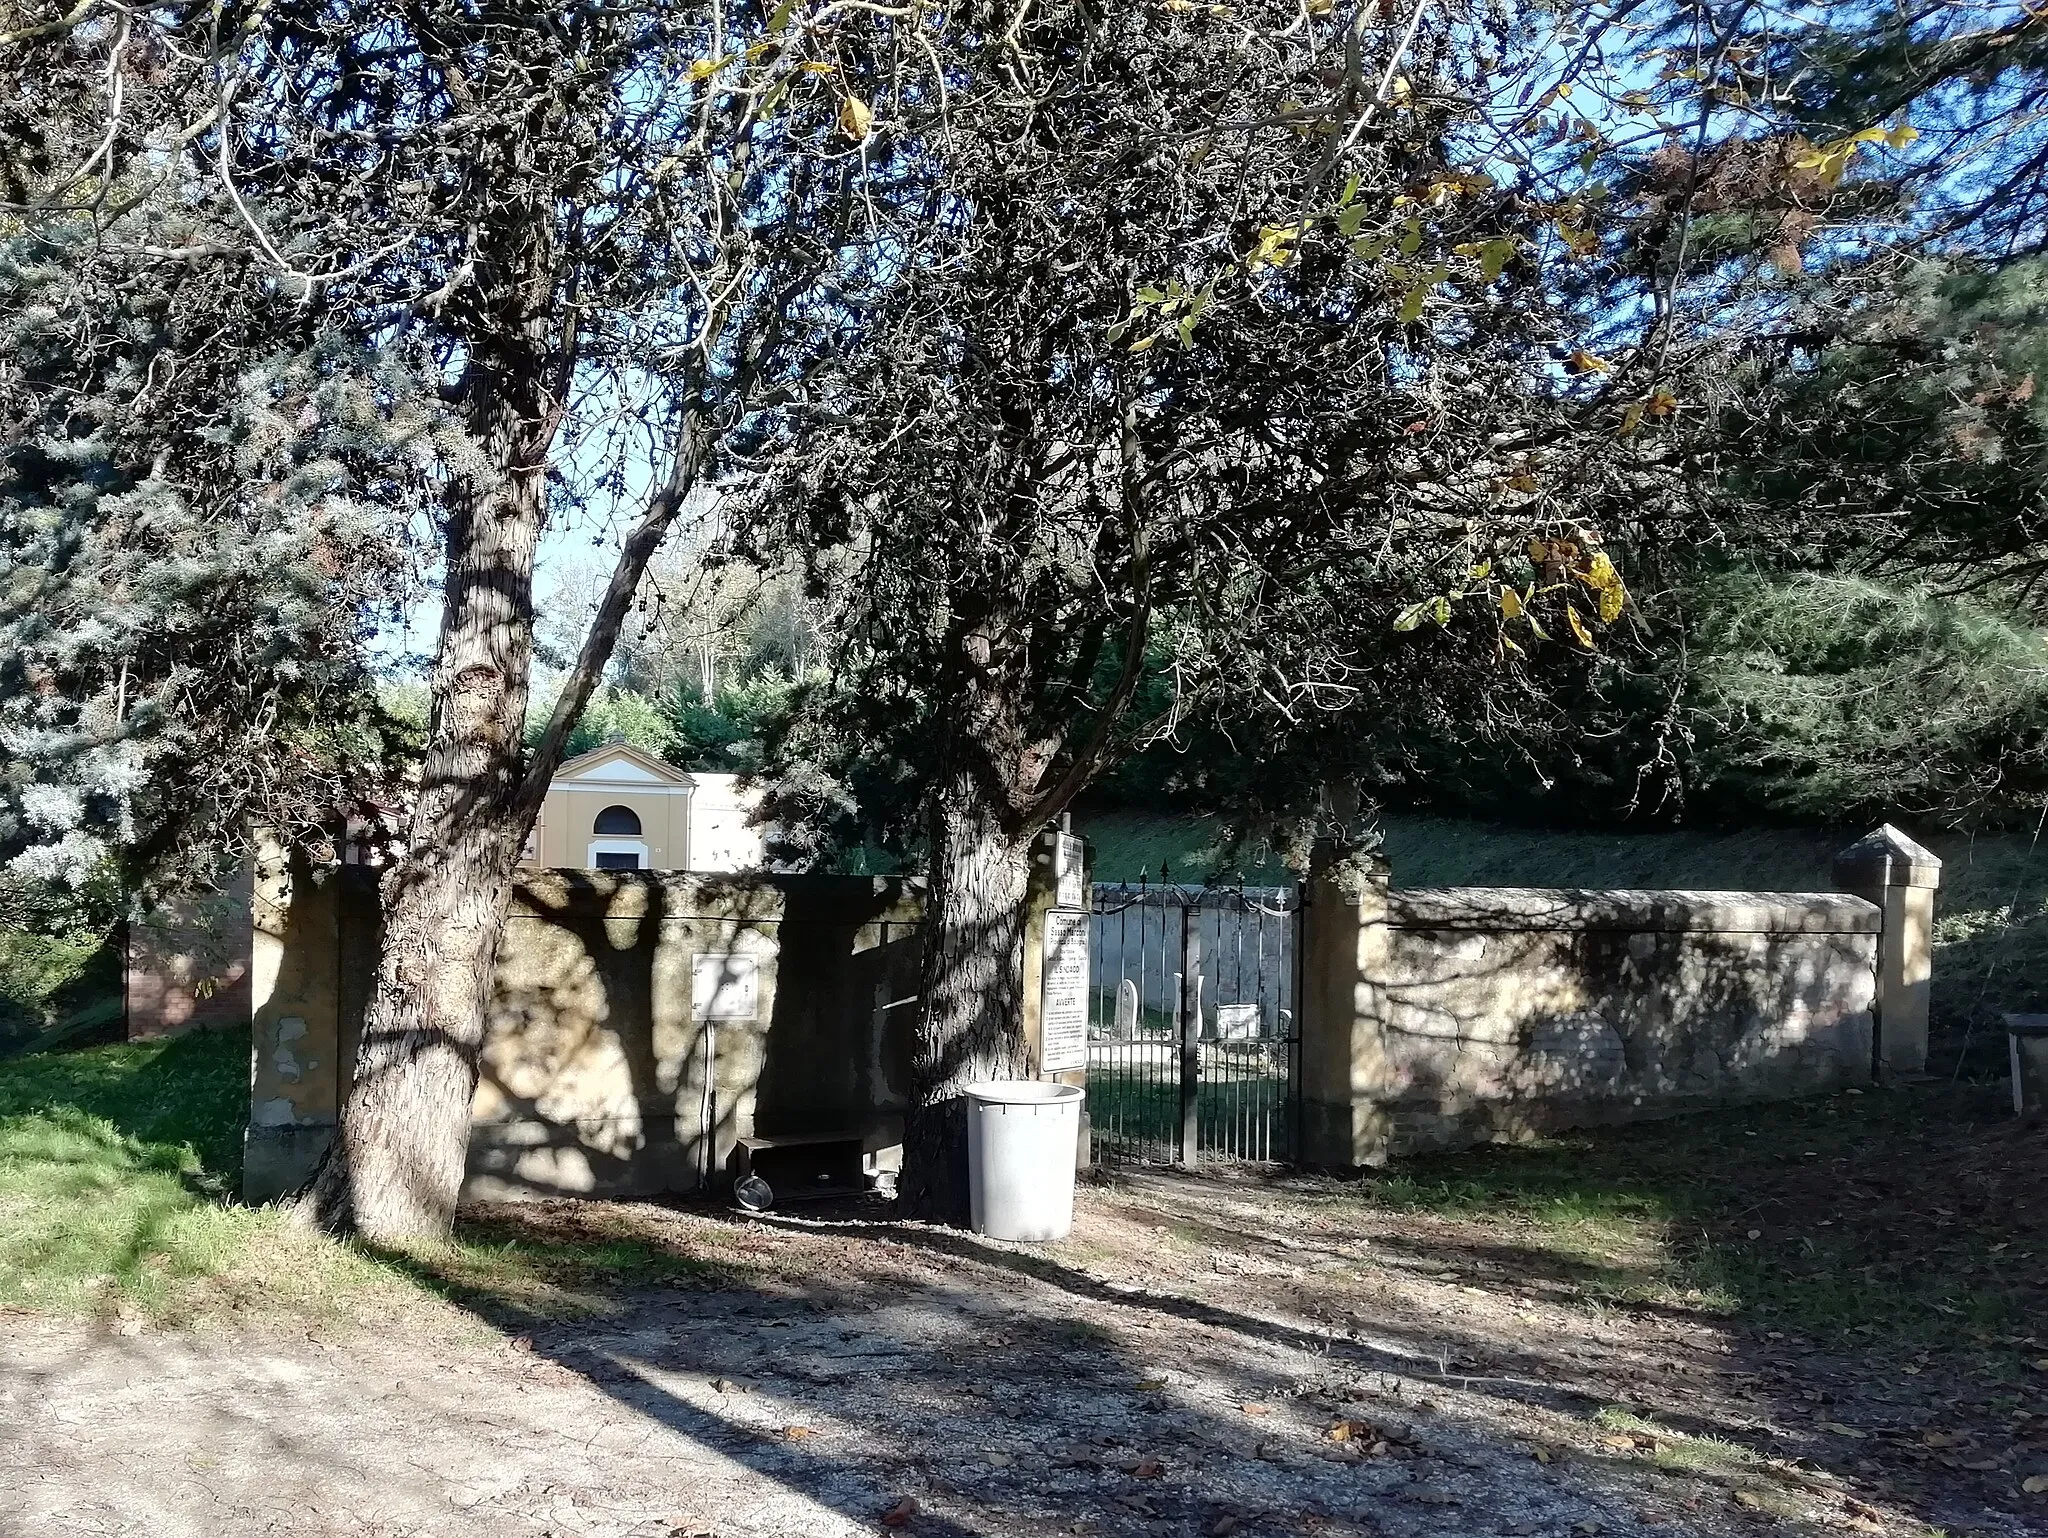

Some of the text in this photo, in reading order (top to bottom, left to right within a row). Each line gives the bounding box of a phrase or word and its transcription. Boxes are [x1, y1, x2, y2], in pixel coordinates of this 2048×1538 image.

[1056, 916, 1076, 926] Comune
[1051, 926, 1086, 936] Sasso Marconi
[1059, 965, 1080, 974] SNDACO
